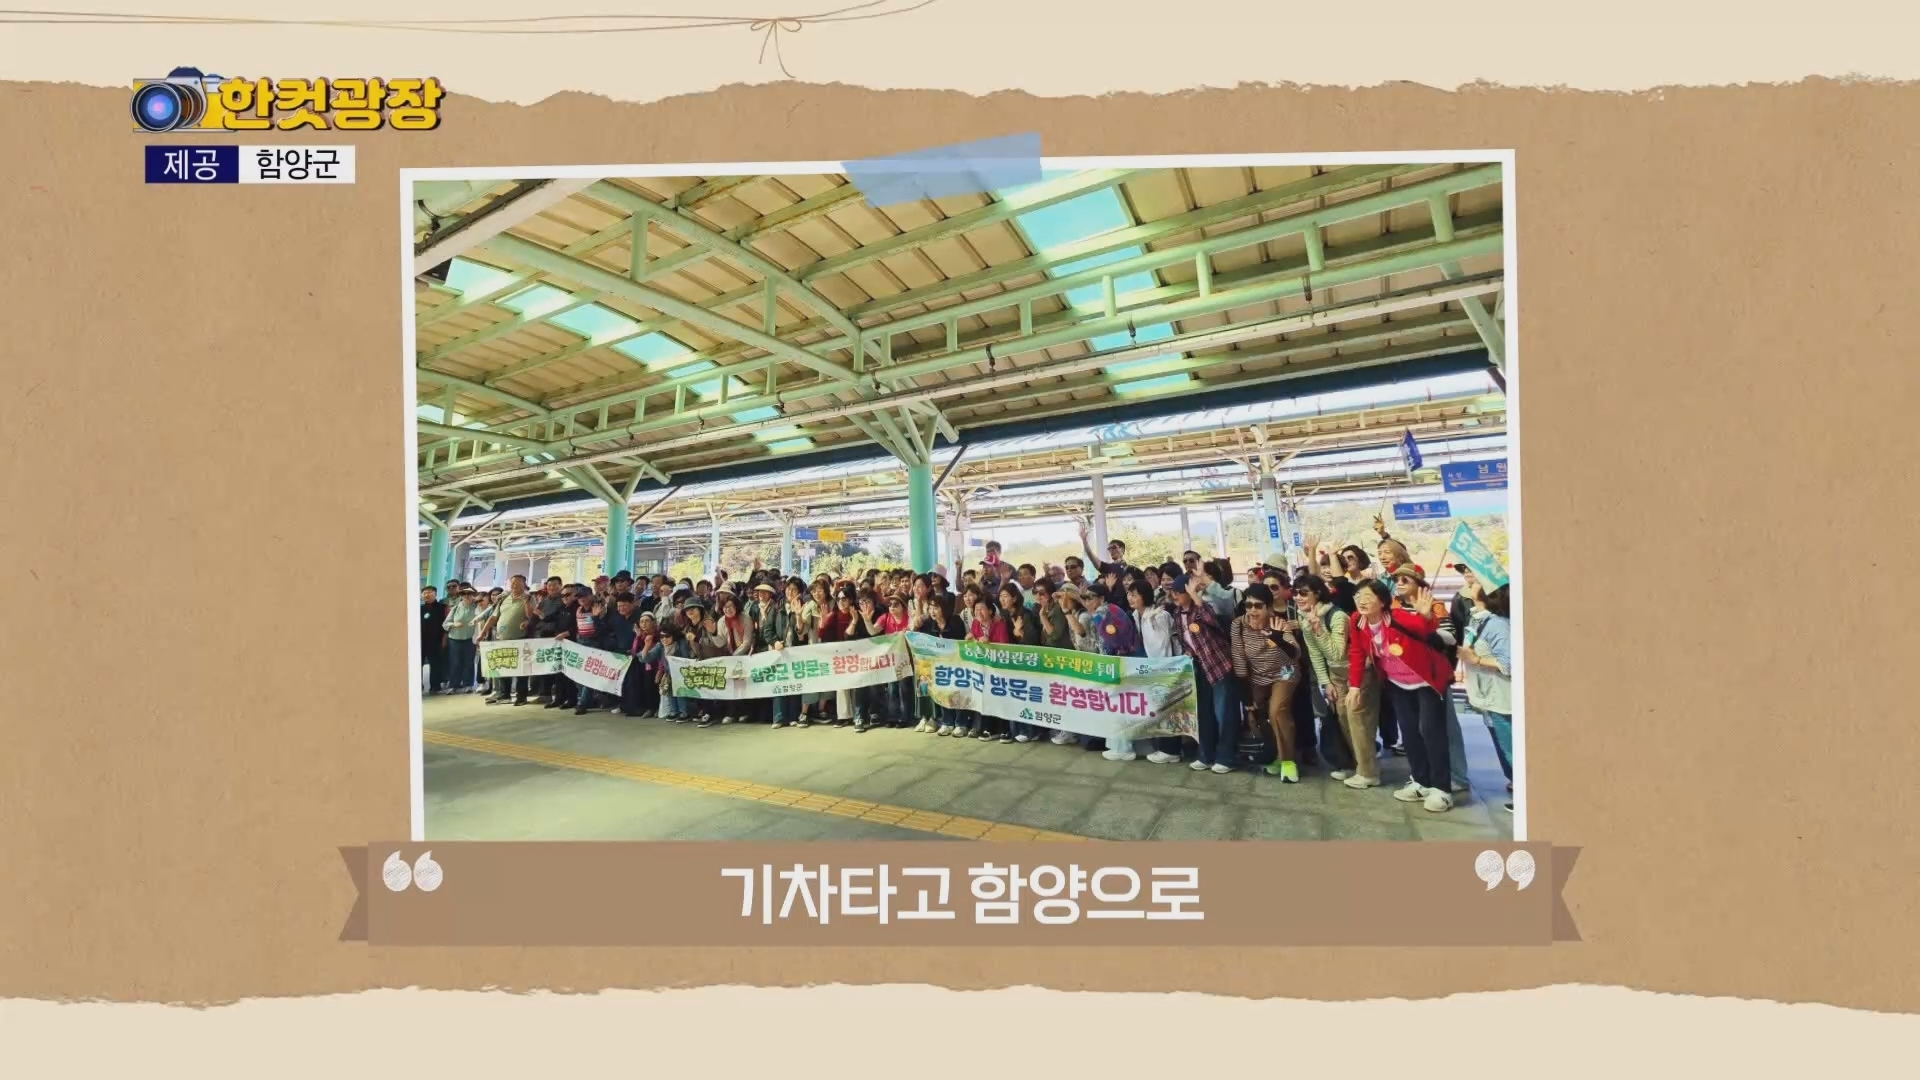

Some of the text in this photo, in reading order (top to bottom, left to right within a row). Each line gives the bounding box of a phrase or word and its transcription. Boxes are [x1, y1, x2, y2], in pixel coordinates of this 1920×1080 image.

[750, 653, 896, 683] 함양군 방문을 환영합니다!
[964, 644, 1039, 666] 농촌체험관광
[1043, 653, 1094, 674] 농뚜레일
[1096, 662, 1115, 679] 투어
[935, 665, 1156, 717] 함양군 방문을 환영합니다.
